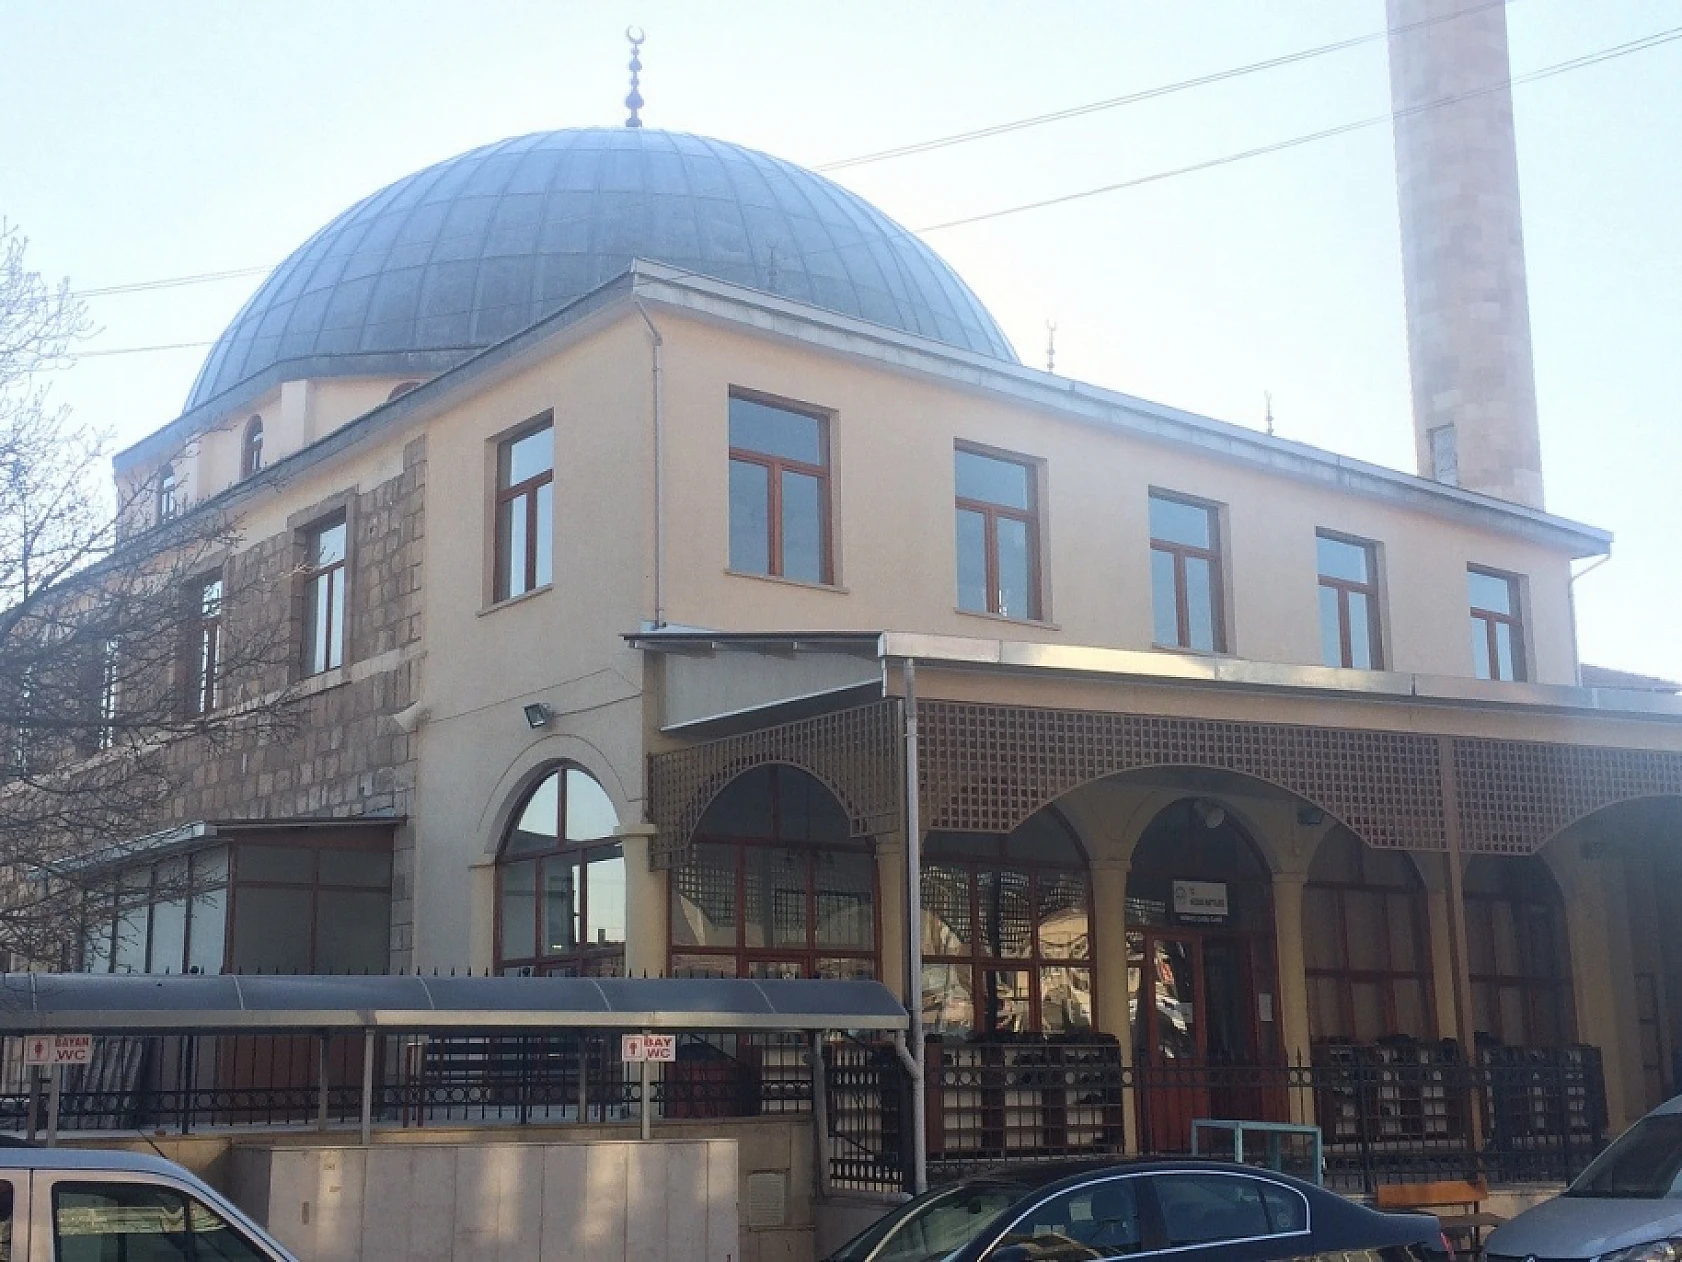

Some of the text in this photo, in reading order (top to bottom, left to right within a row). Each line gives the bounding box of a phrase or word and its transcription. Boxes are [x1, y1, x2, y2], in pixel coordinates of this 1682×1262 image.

[55, 1037, 89, 1048] BAYAN
[644, 1037, 672, 1048] BAY
[57, 1049, 86, 1061] WC
[647, 1048, 671, 1059] WC
